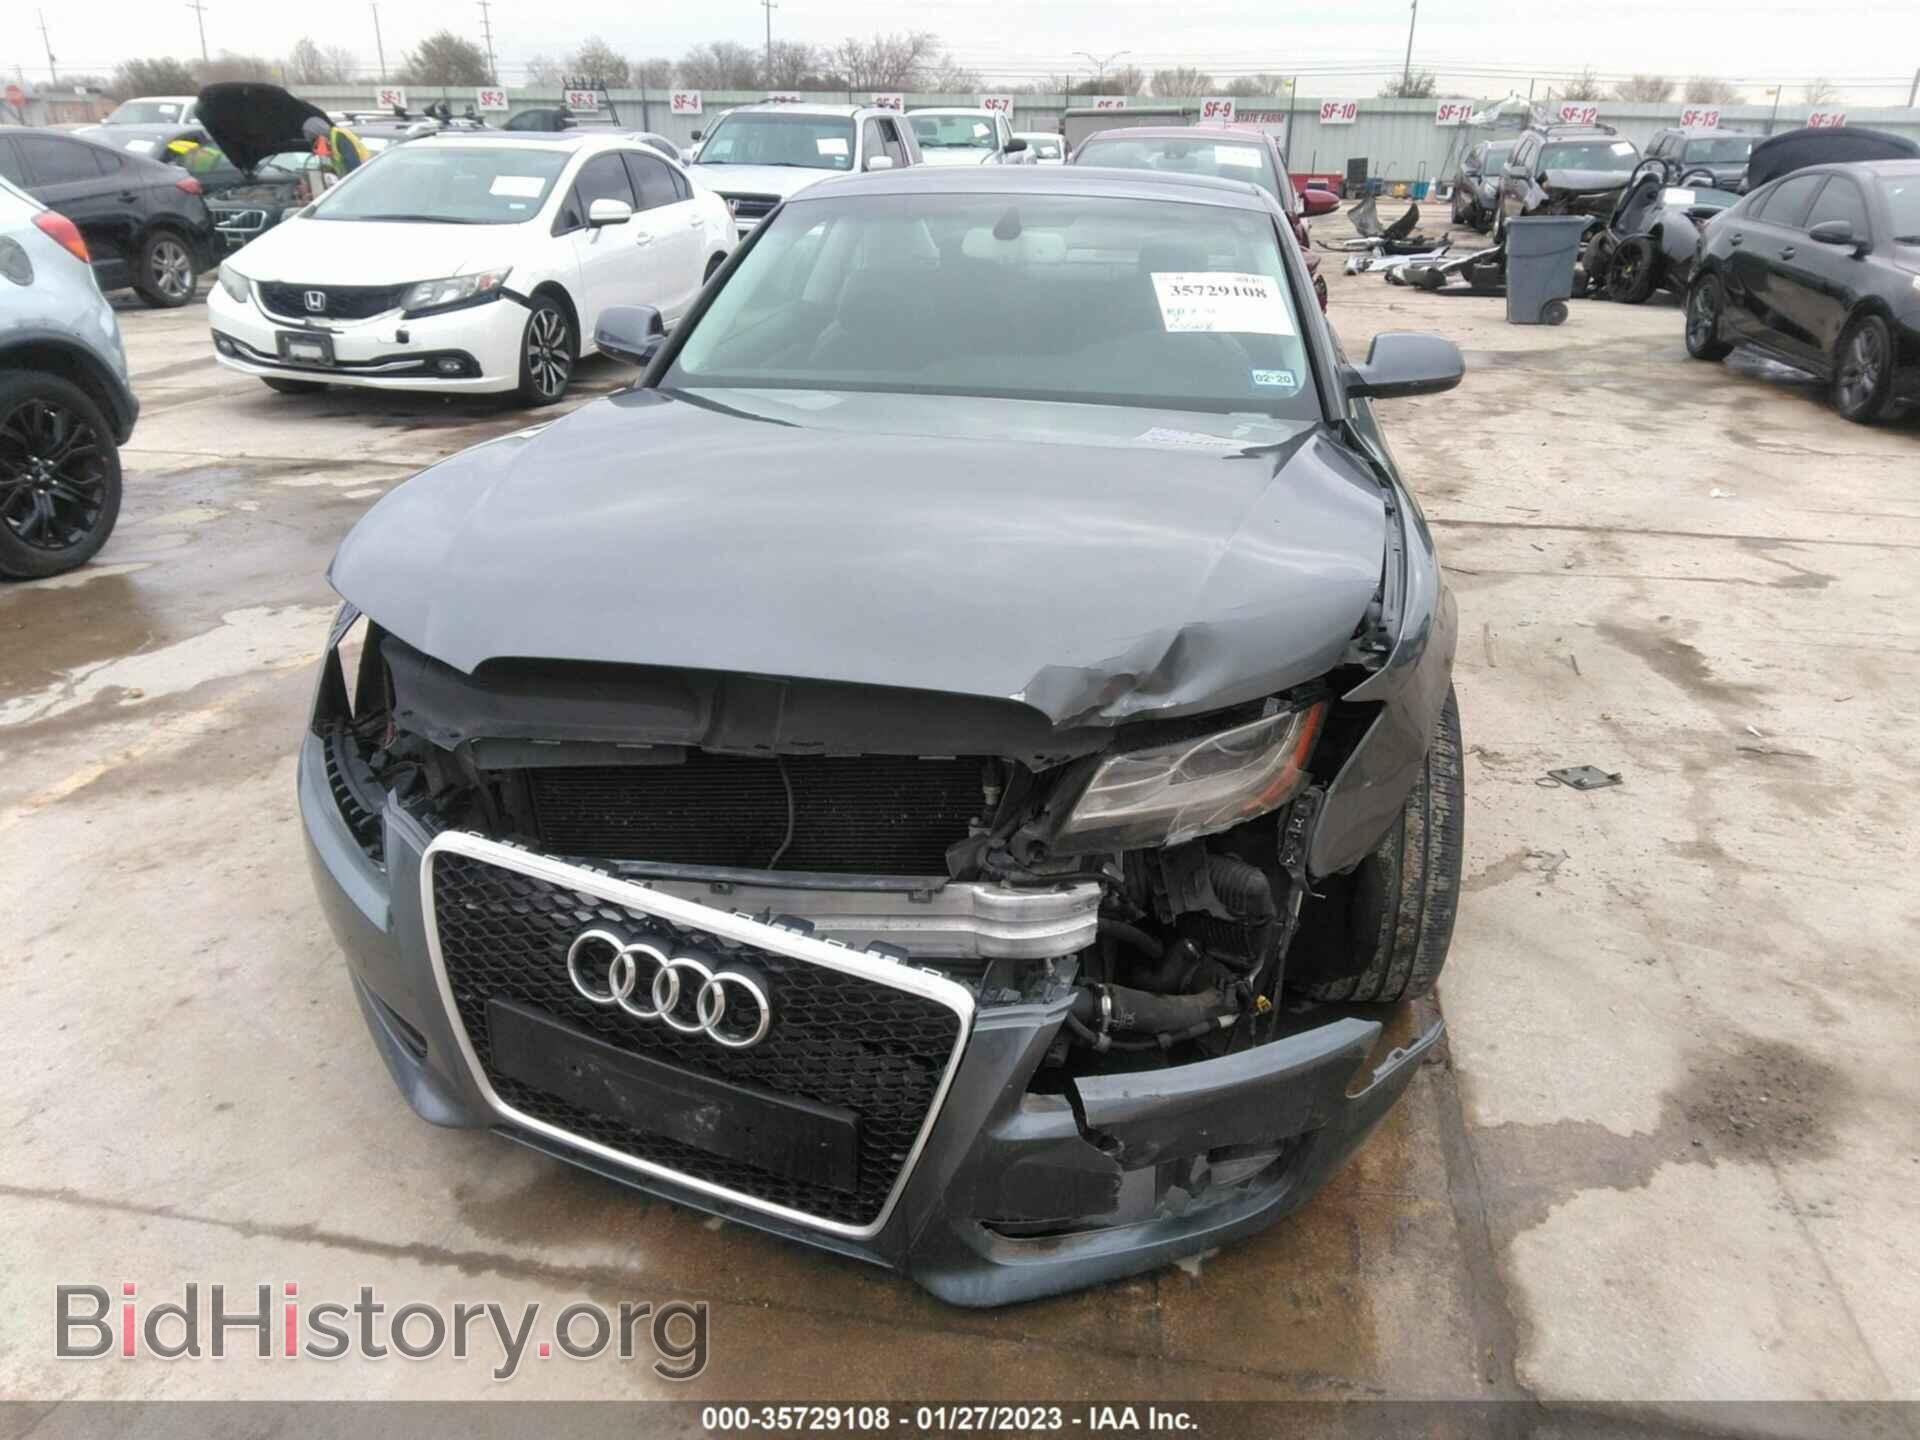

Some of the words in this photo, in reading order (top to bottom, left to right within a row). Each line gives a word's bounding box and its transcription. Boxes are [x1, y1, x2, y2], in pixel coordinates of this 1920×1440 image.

[381, 90, 401, 104] SF-1
[480, 91, 504, 106] SF-2
[570, 92, 593, 106] SF-3
[673, 95, 698, 109] SF-4
[984, 99, 1009, 112] SF-7
[1204, 102, 1232, 117] SF-9
[1320, 102, 1356, 119] SF-10
[1438, 104, 1472, 120] SF-11
[1562, 107, 1596, 122] SF-12
[1682, 110, 1719, 127] SF-13
[1809, 113, 1846, 128] SF-14
[1170, 285, 1268, 299] 35729108
